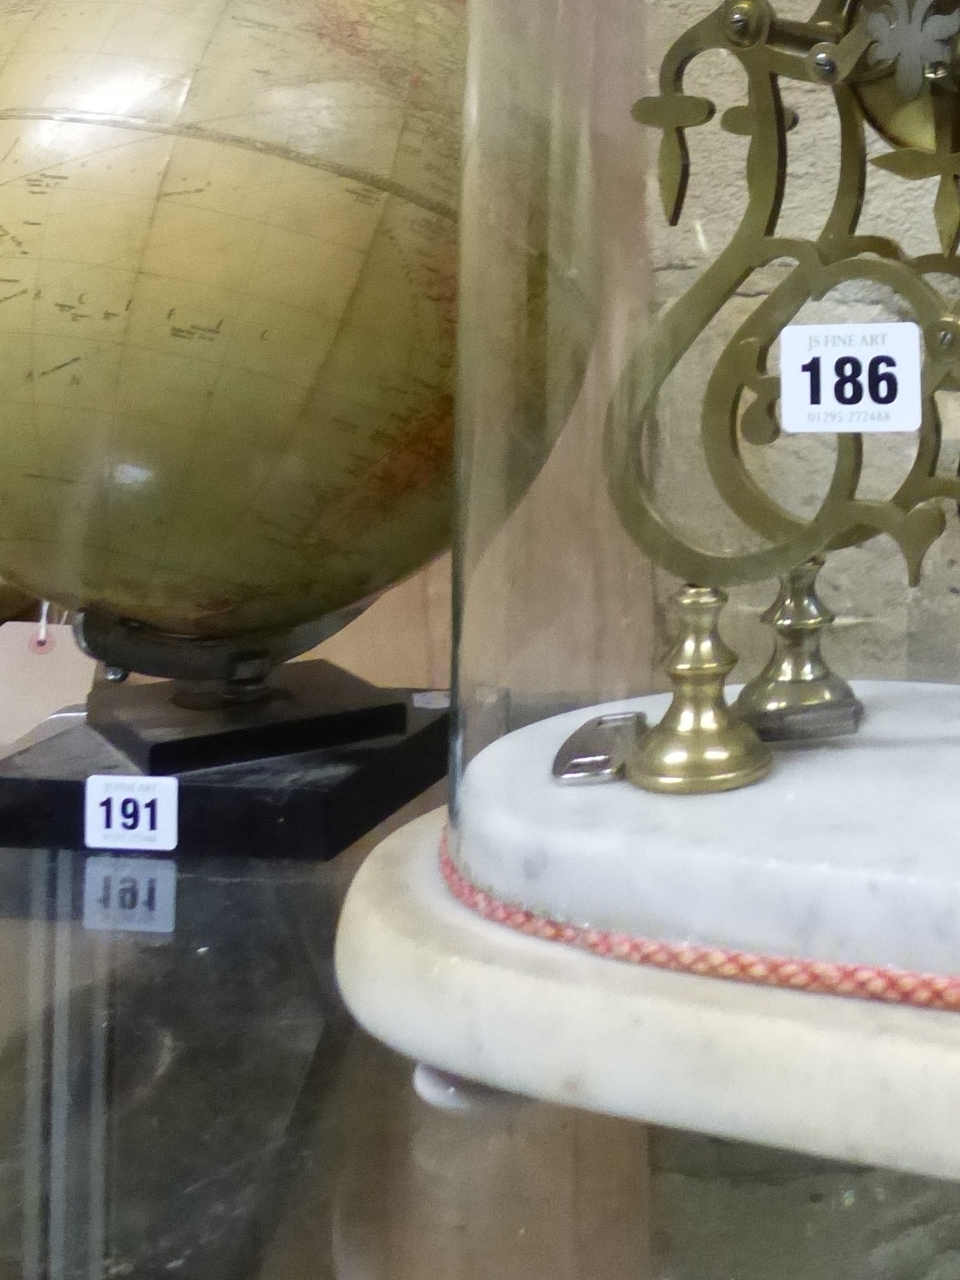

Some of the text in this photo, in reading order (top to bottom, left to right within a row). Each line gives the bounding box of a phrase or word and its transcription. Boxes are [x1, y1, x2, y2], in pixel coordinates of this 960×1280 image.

[824, 333, 857, 348] FINE
[860, 332, 888, 347] ART
[800, 354, 899, 406] 186
[807, 411, 844, 423] 01295
[99, 796, 158, 831] 191
